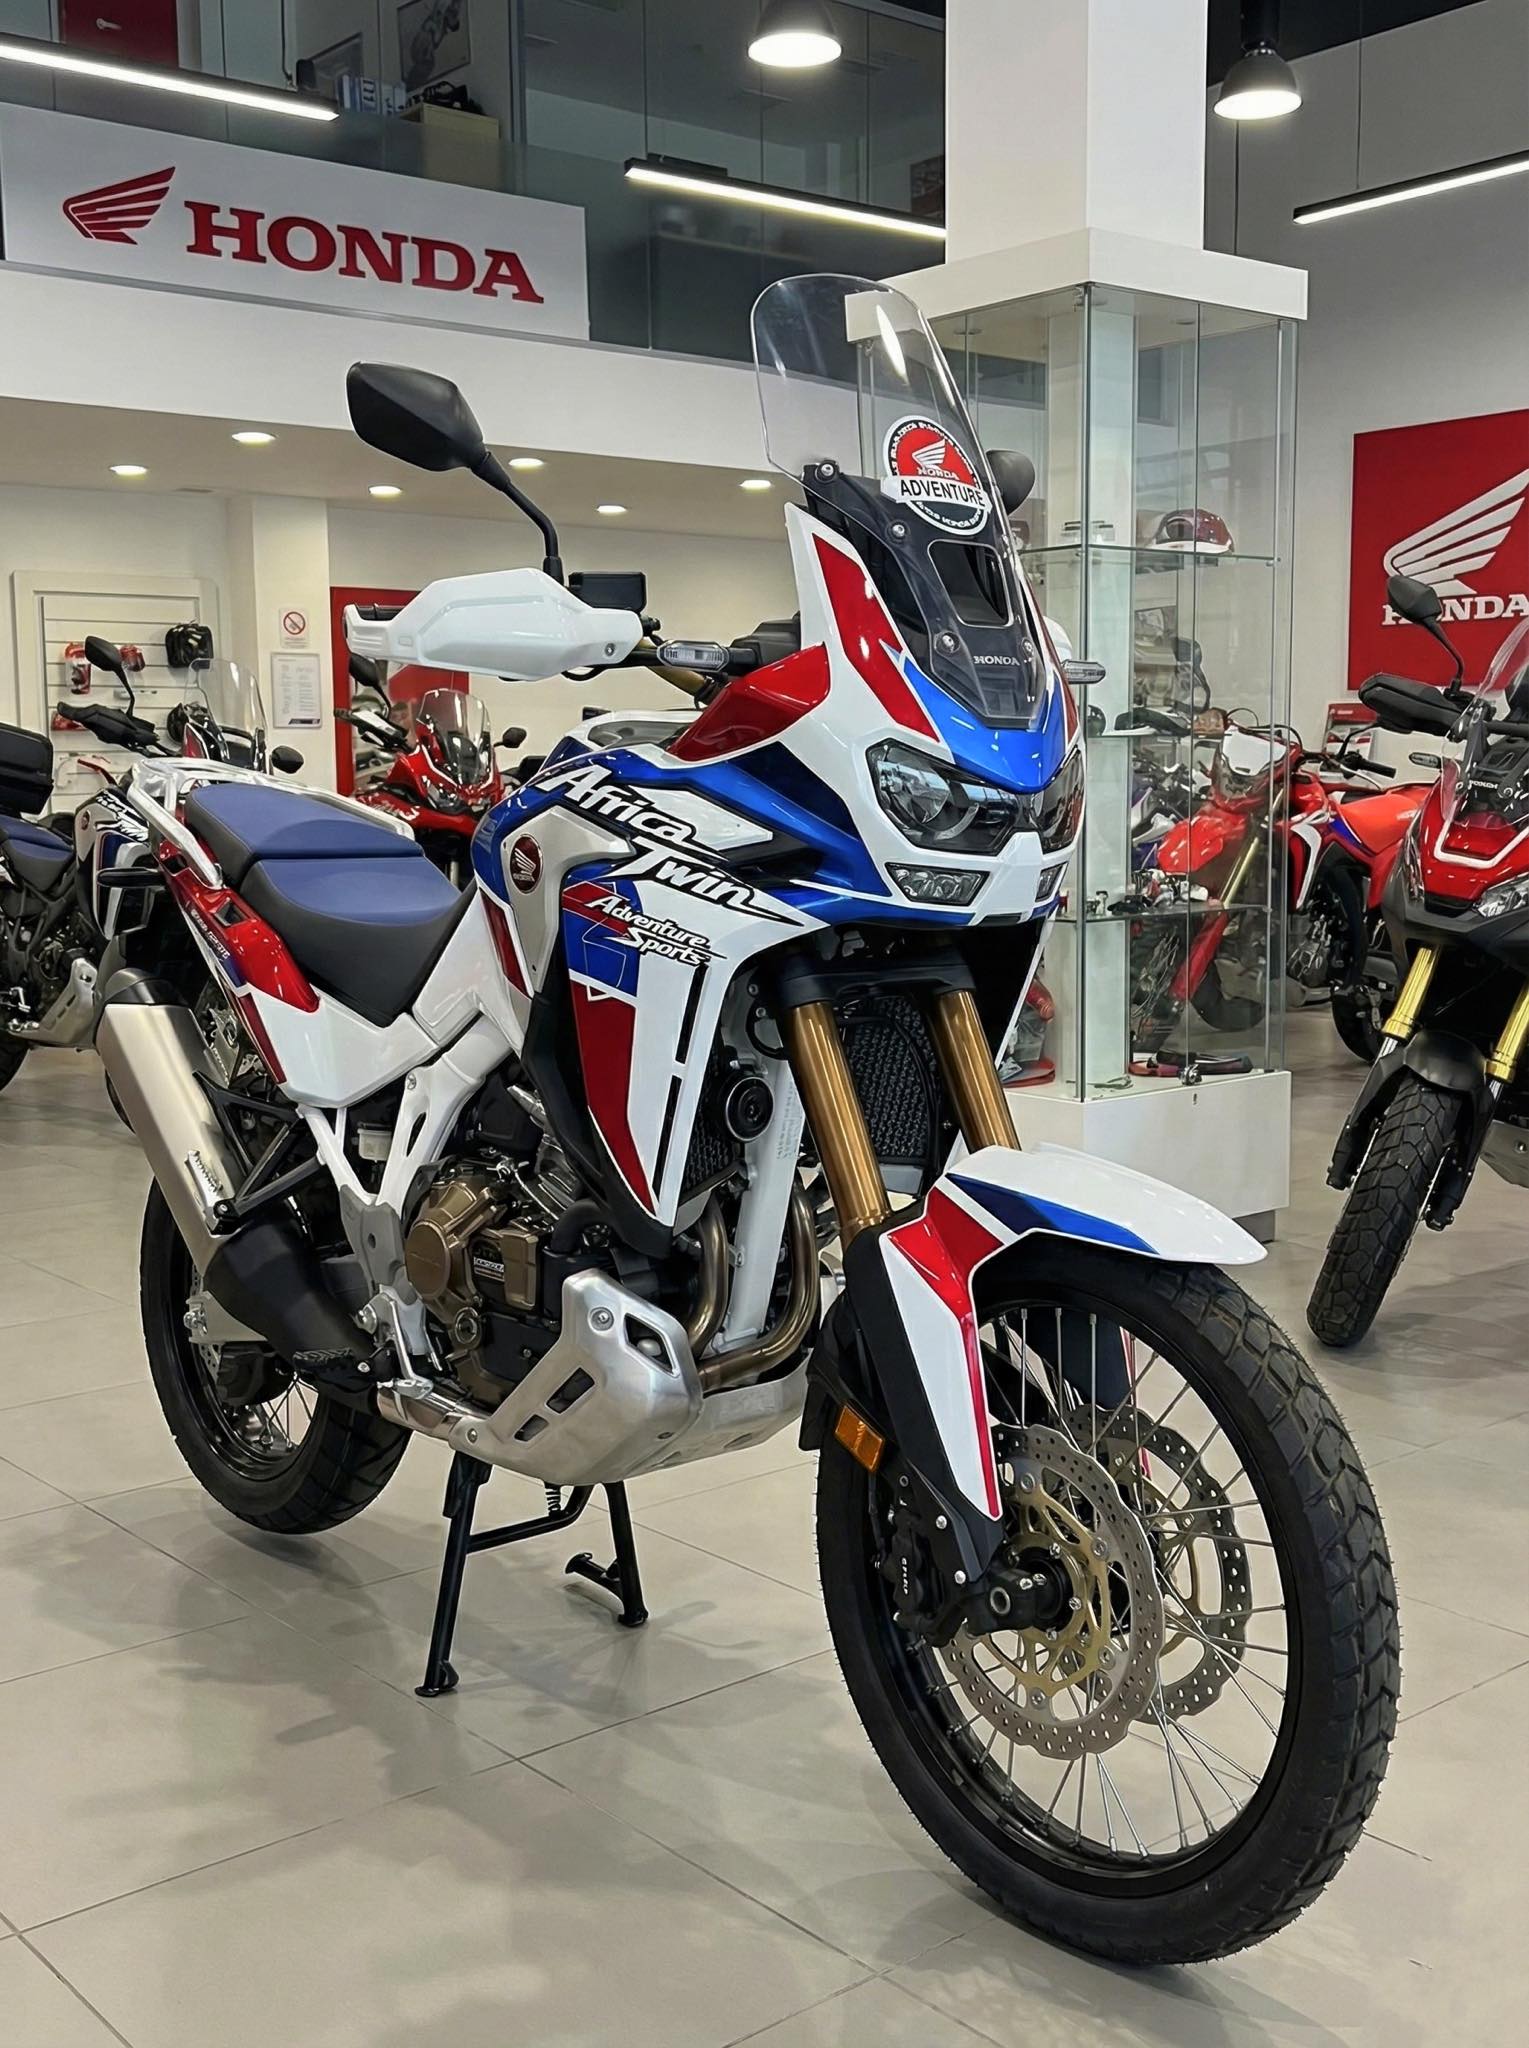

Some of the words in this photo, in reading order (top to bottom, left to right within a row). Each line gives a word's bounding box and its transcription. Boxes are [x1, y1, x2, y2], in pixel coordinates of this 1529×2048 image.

[184, 200, 544, 304] HONDA
[900, 479, 986, 508] ADVENTURE
[917, 467, 960, 480] HONDA
[973, 655, 1020, 666] HONDA
[535, 764, 729, 861] Africa
[602, 835, 804, 926] Twin
[585, 894, 713, 949] Adventure
[605, 926, 728, 967] Sports
